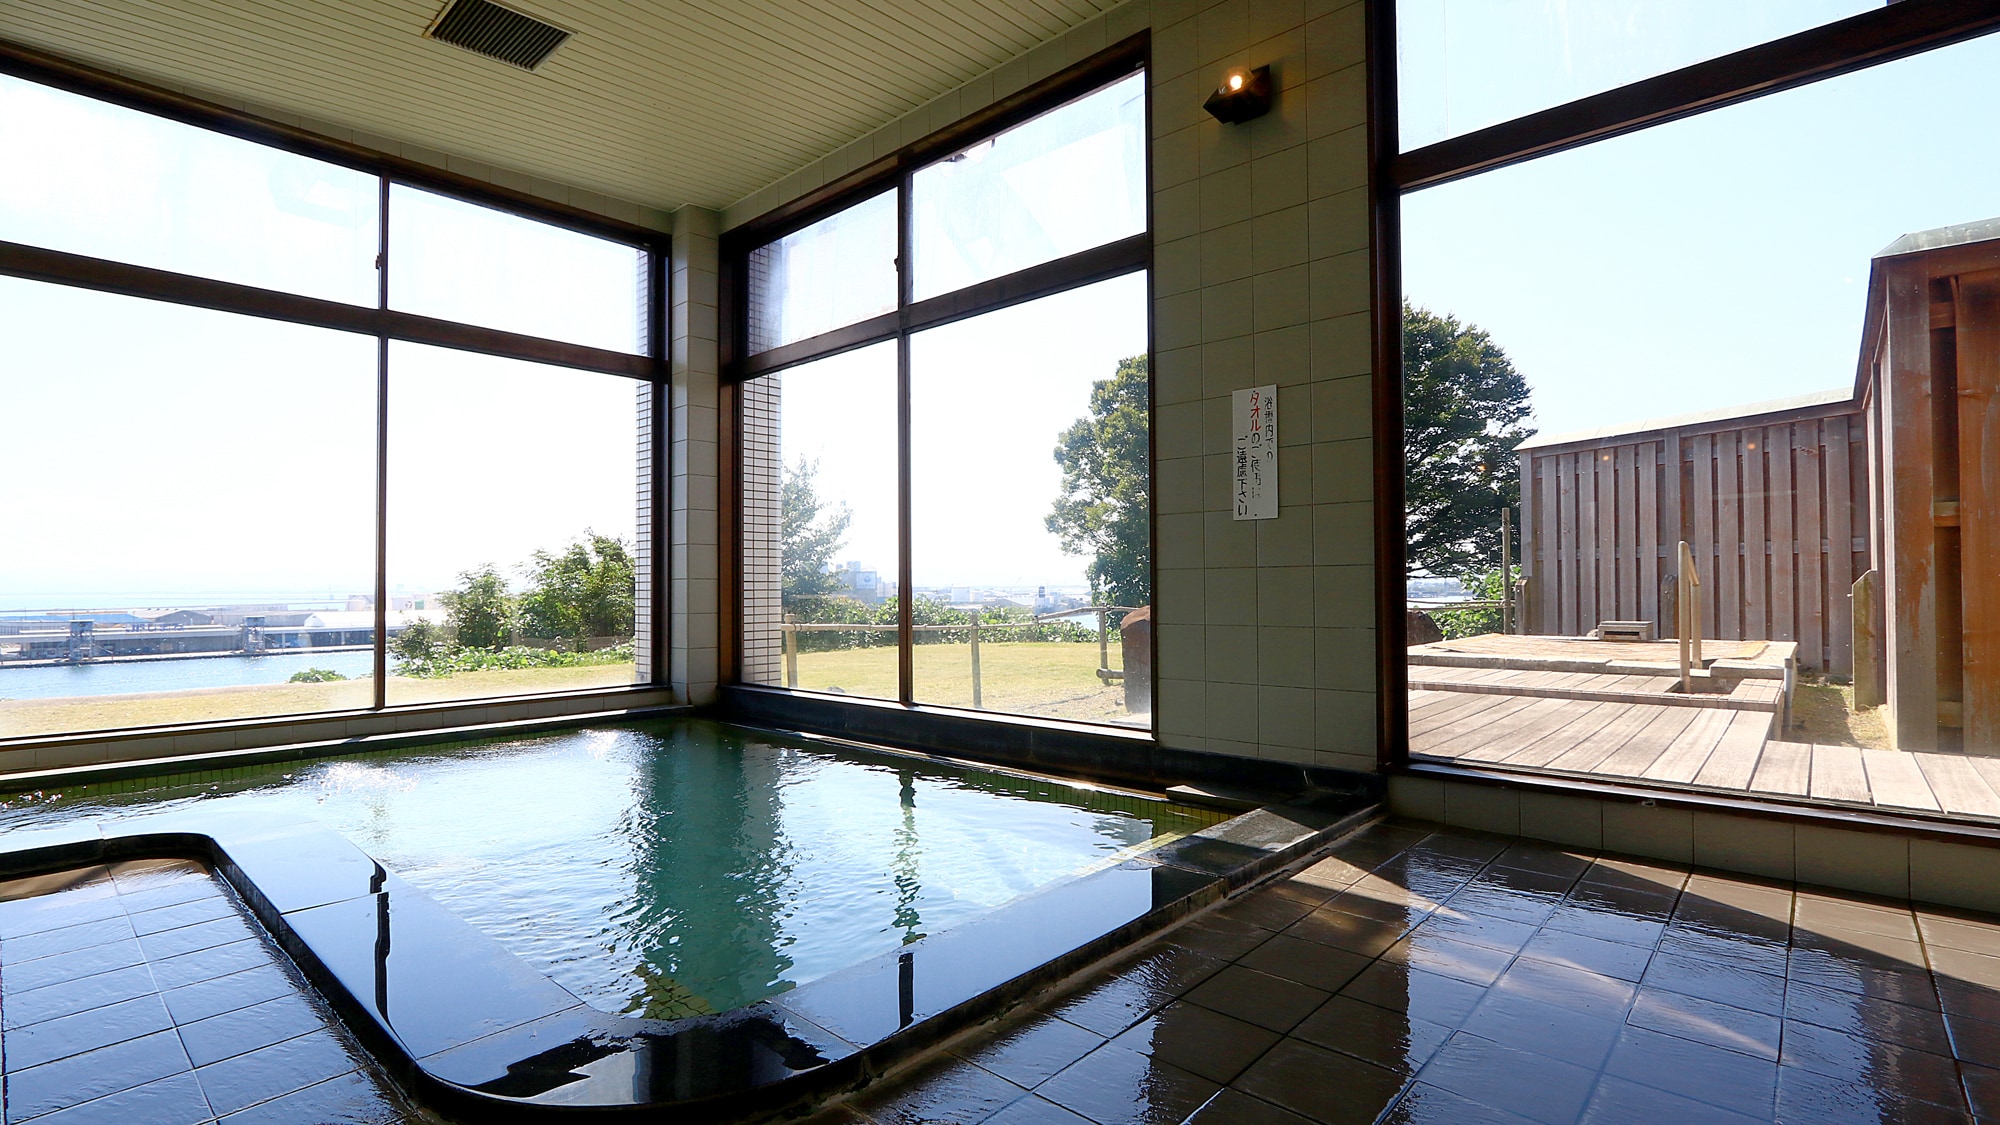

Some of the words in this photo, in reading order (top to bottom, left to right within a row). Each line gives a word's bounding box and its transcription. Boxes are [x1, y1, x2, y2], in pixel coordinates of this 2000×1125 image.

[1236, 435, 1248, 516] ご遠慮下さい
